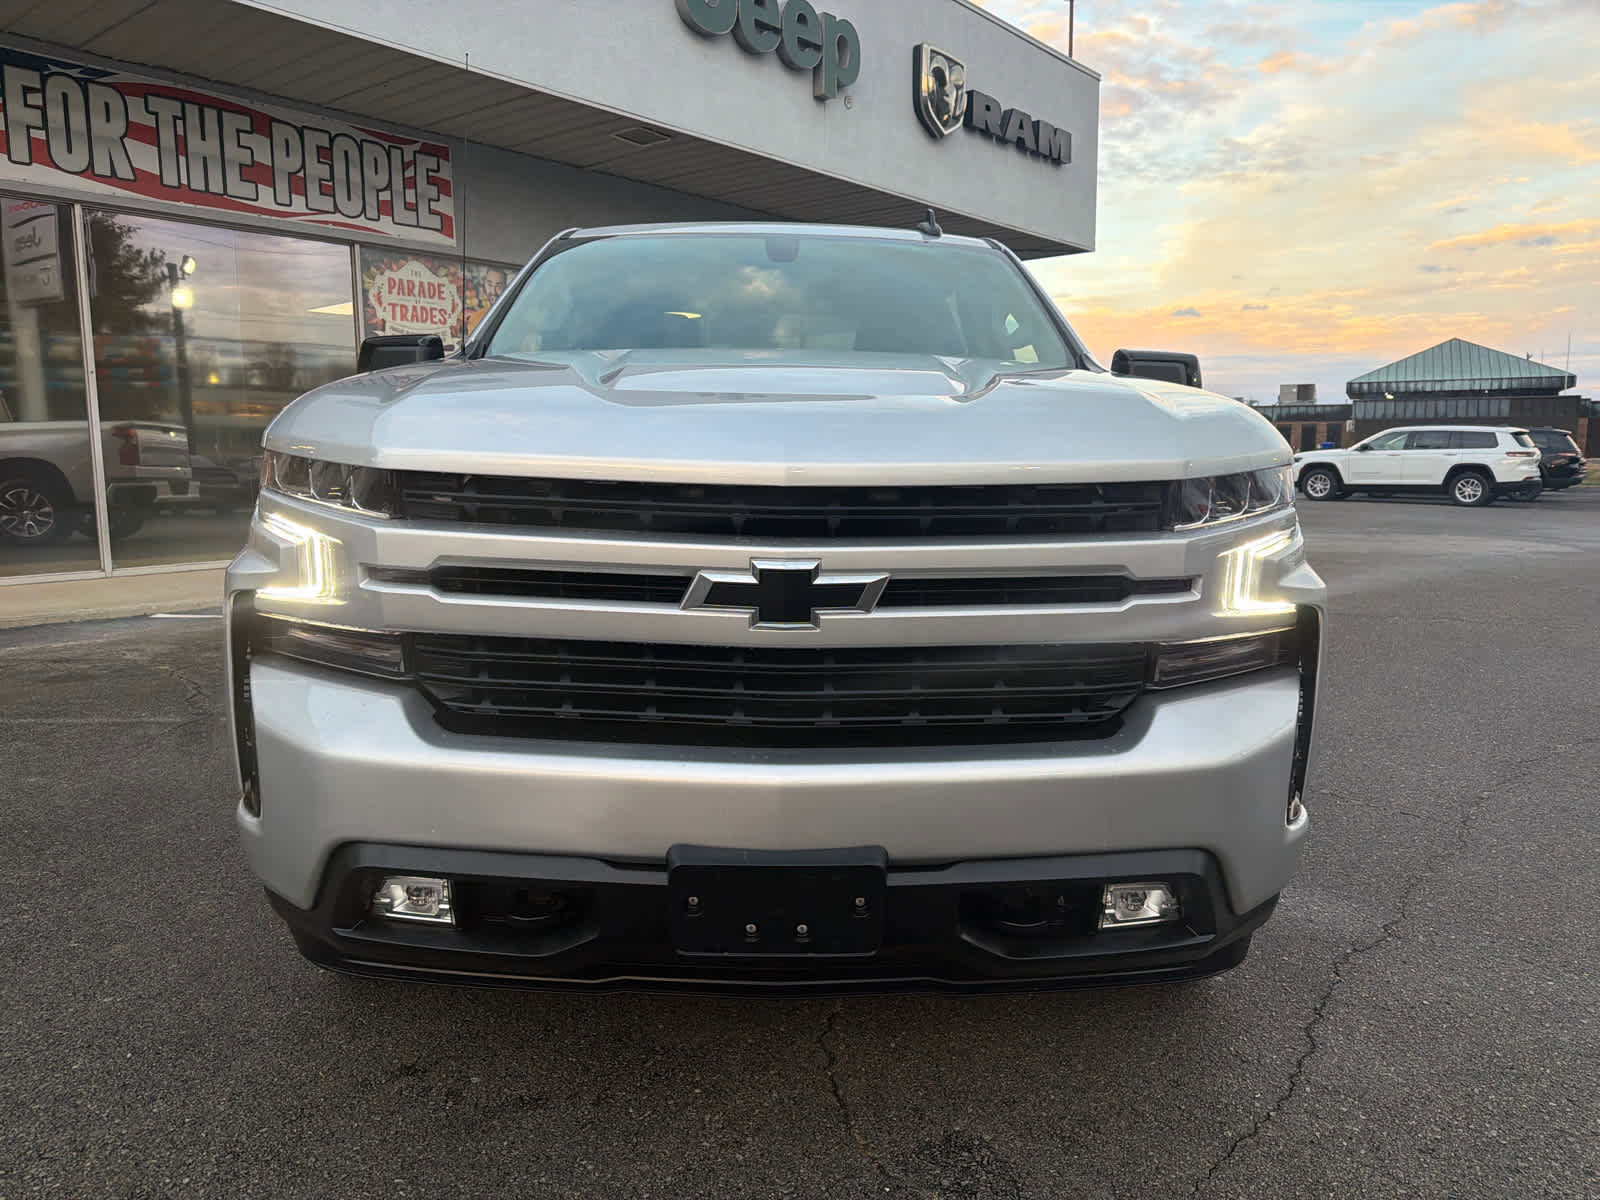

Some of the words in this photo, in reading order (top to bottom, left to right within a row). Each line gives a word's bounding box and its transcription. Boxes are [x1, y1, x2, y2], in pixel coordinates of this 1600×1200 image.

[2, 63, 137, 183] FOR
[144, 93, 260, 202] THE
[269, 117, 444, 232] PEOPLE
[963, 89, 1072, 165] RAM
[387, 276, 446, 301] PARADE
[387, 302, 448, 326] TRADES
